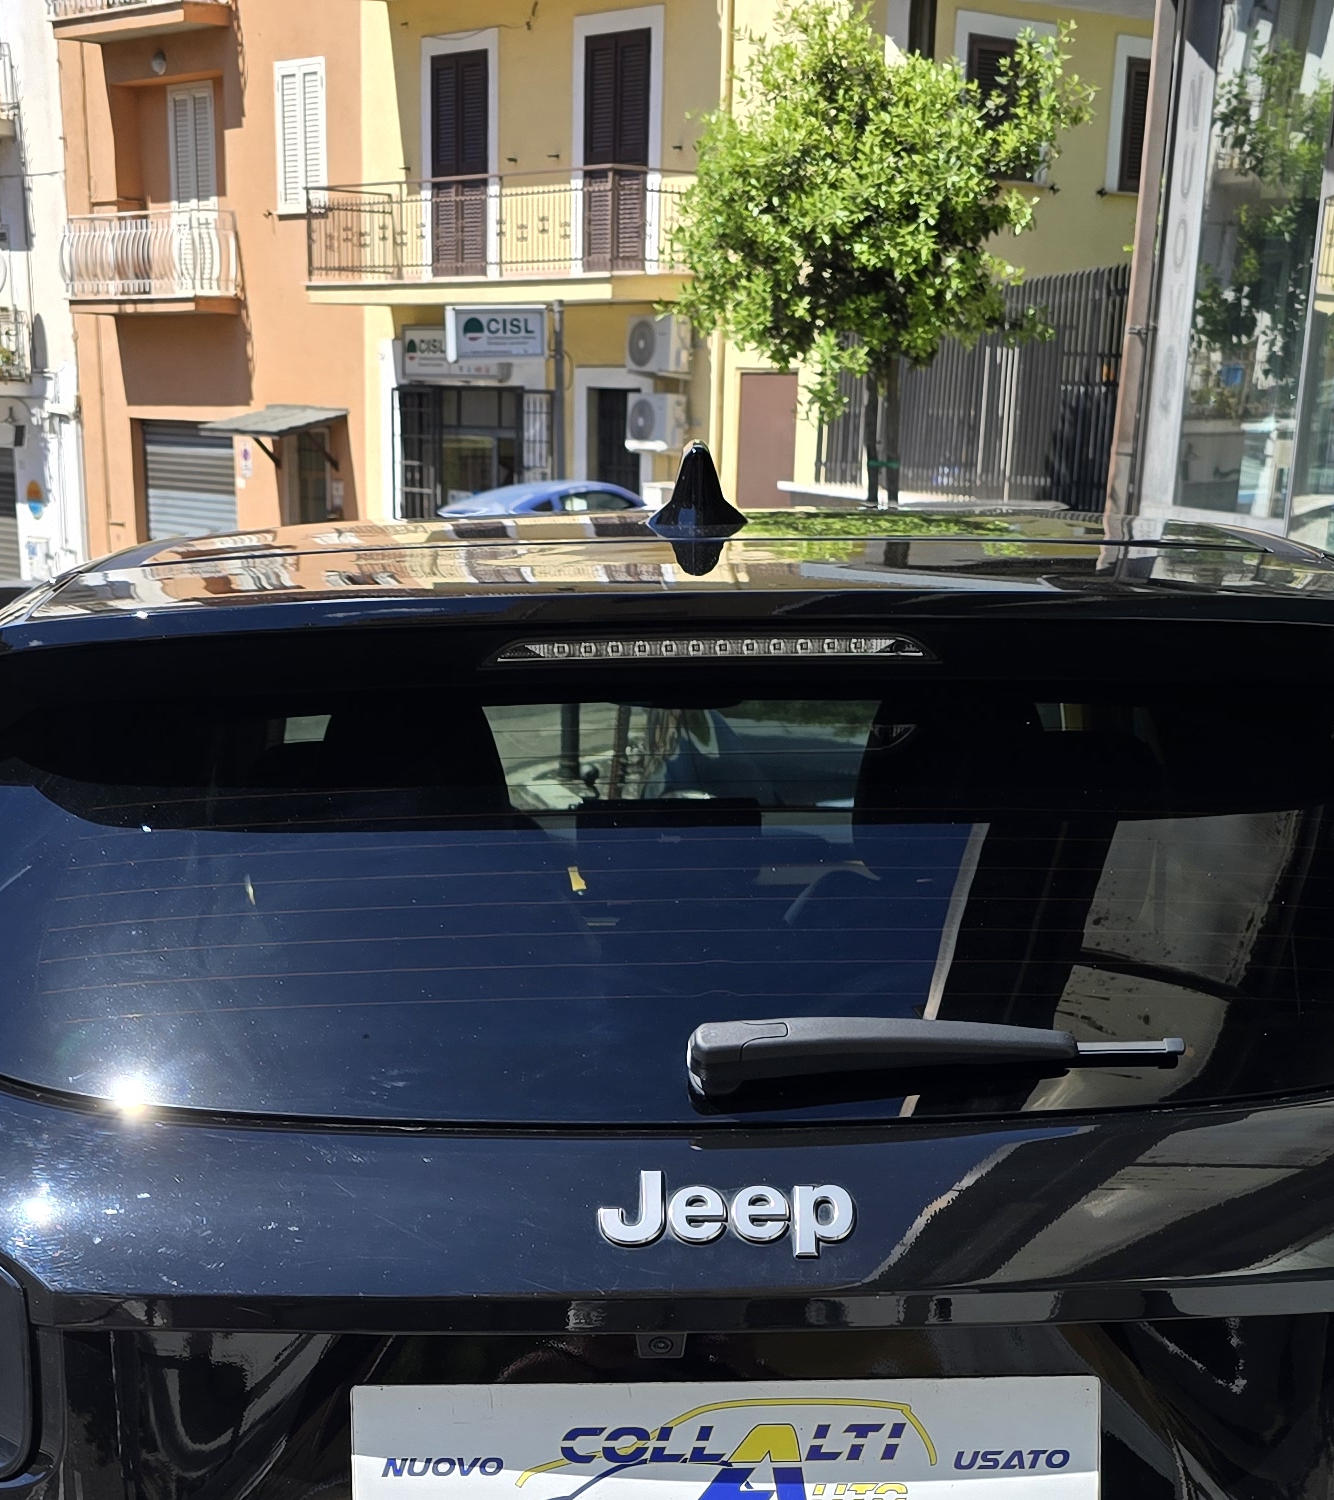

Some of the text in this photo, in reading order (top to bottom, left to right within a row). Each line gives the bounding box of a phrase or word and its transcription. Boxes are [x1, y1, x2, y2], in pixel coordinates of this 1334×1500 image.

[486, 317, 535, 335] CISL
[597, 1170, 856, 1259] Jeep
[560, 1423, 907, 1464] COLLALTI
[381, 1456, 504, 1477] NUOVO
[953, 1449, 1071, 1470] USATO
